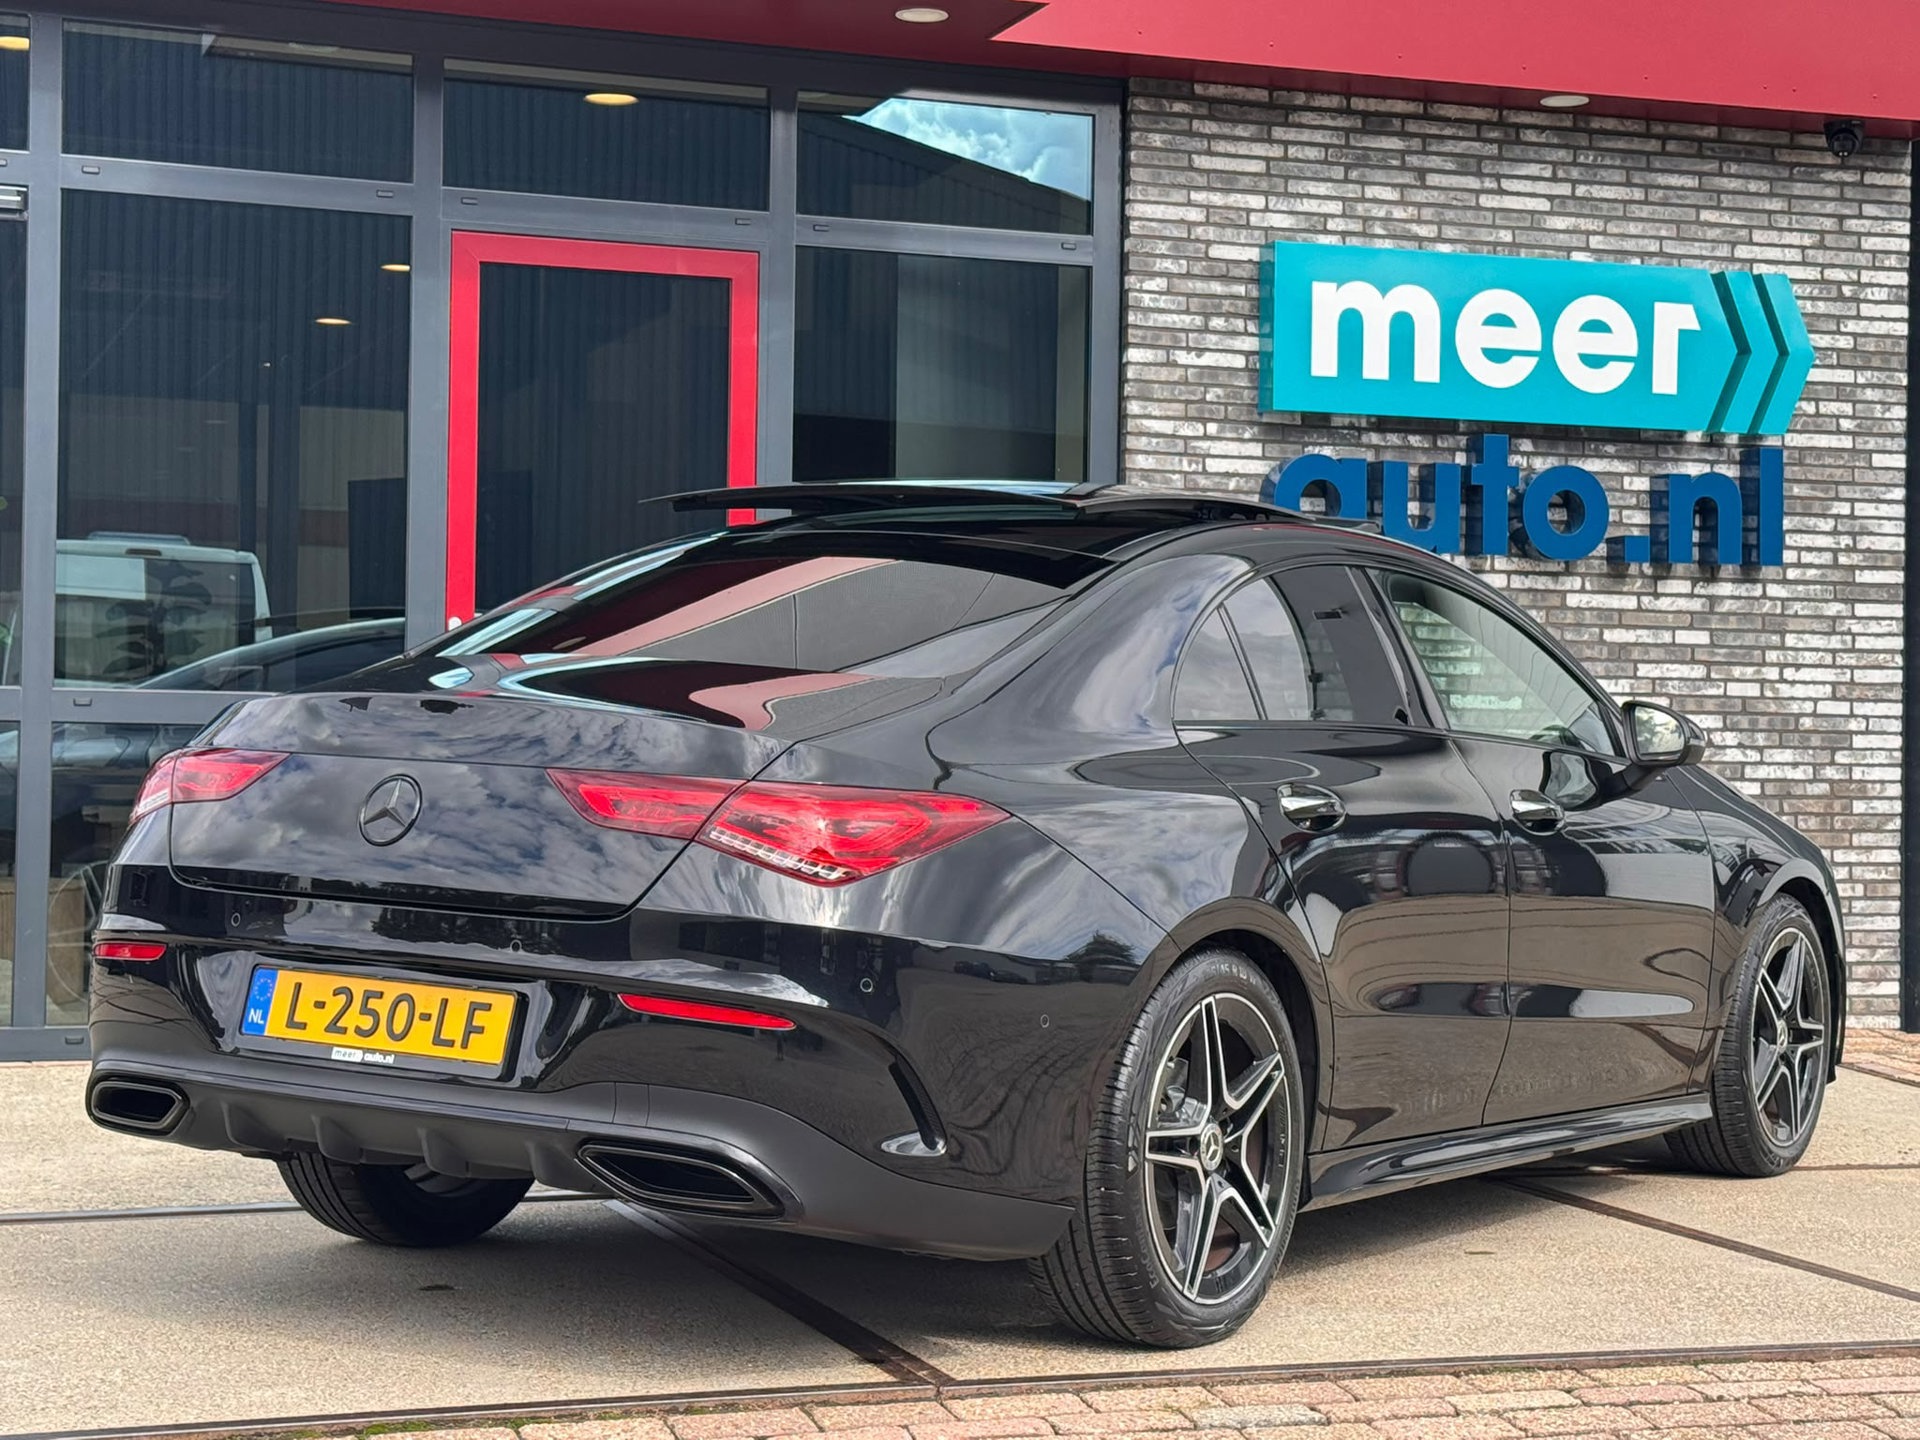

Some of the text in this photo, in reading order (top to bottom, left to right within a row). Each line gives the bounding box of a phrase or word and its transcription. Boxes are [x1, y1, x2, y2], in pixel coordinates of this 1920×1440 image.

[1310, 280, 1701, 395] meer
[1265, 434, 1784, 567] auto.nl
[248, 1008, 265, 1024] NL
[285, 982, 492, 1049] L-250-LF
